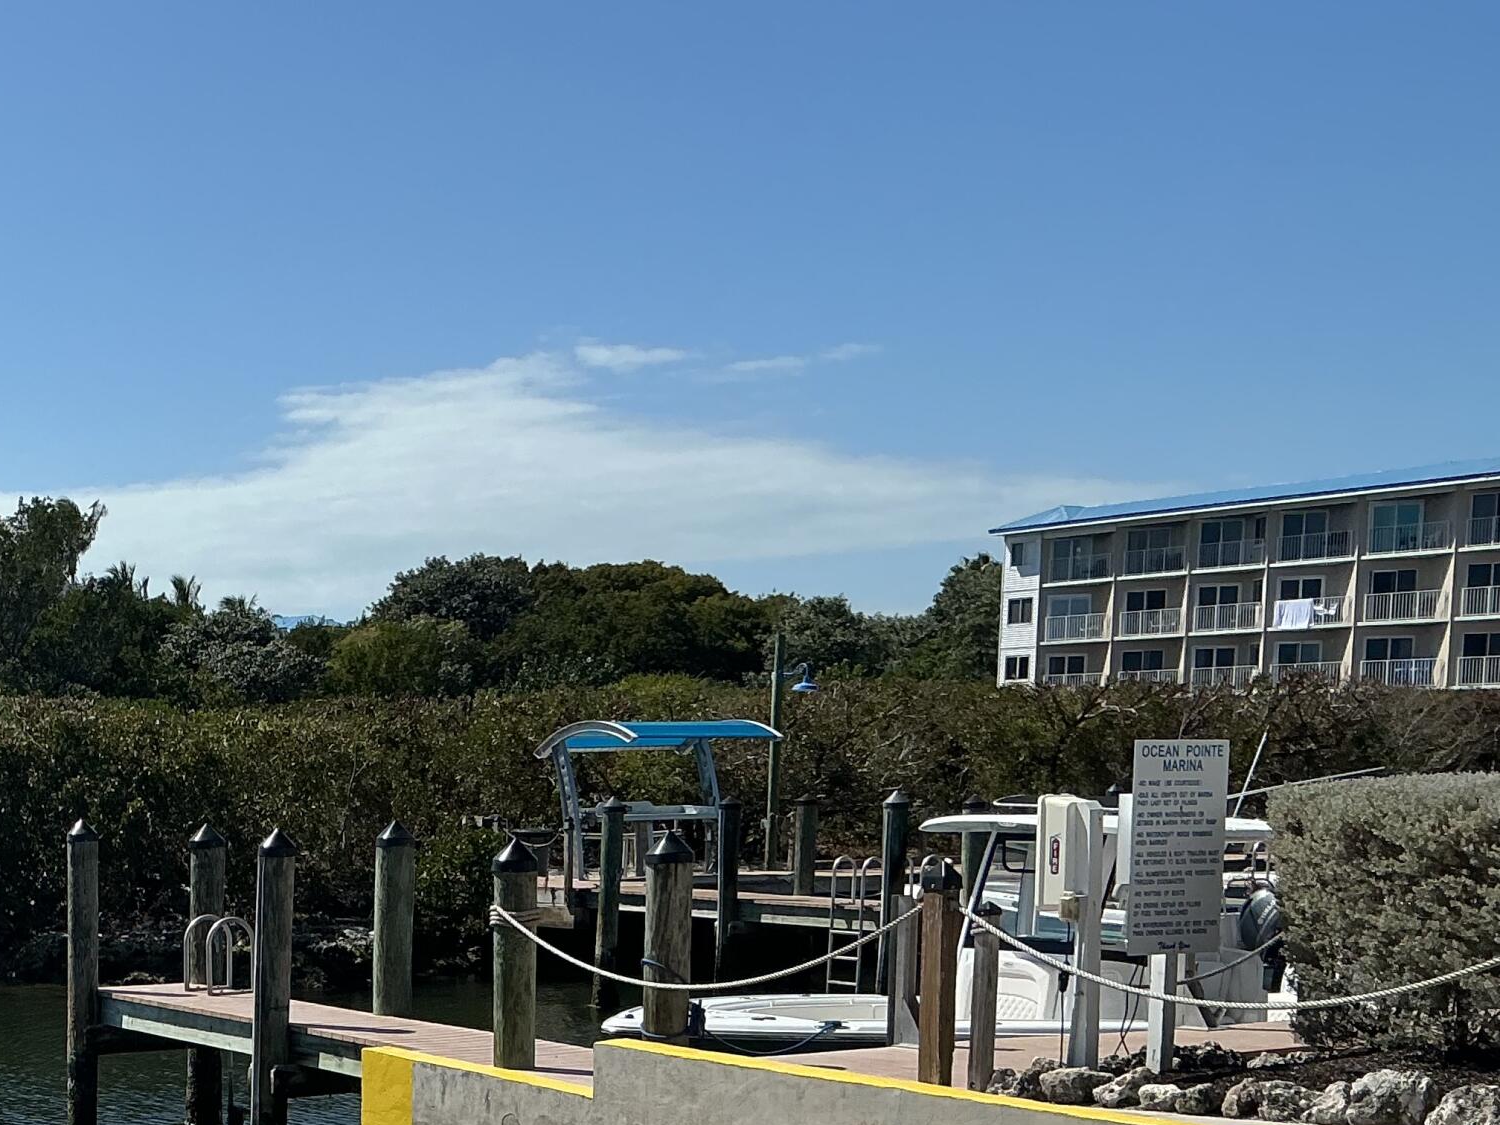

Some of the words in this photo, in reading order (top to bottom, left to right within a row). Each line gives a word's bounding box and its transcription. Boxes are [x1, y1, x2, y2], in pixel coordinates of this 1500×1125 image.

[1141, 744, 1180, 758] OCEAN
[1186, 744, 1224, 757] POINTE
[1163, 759, 1204, 771] MARINA
[1051, 842, 1059, 873] FIRE
